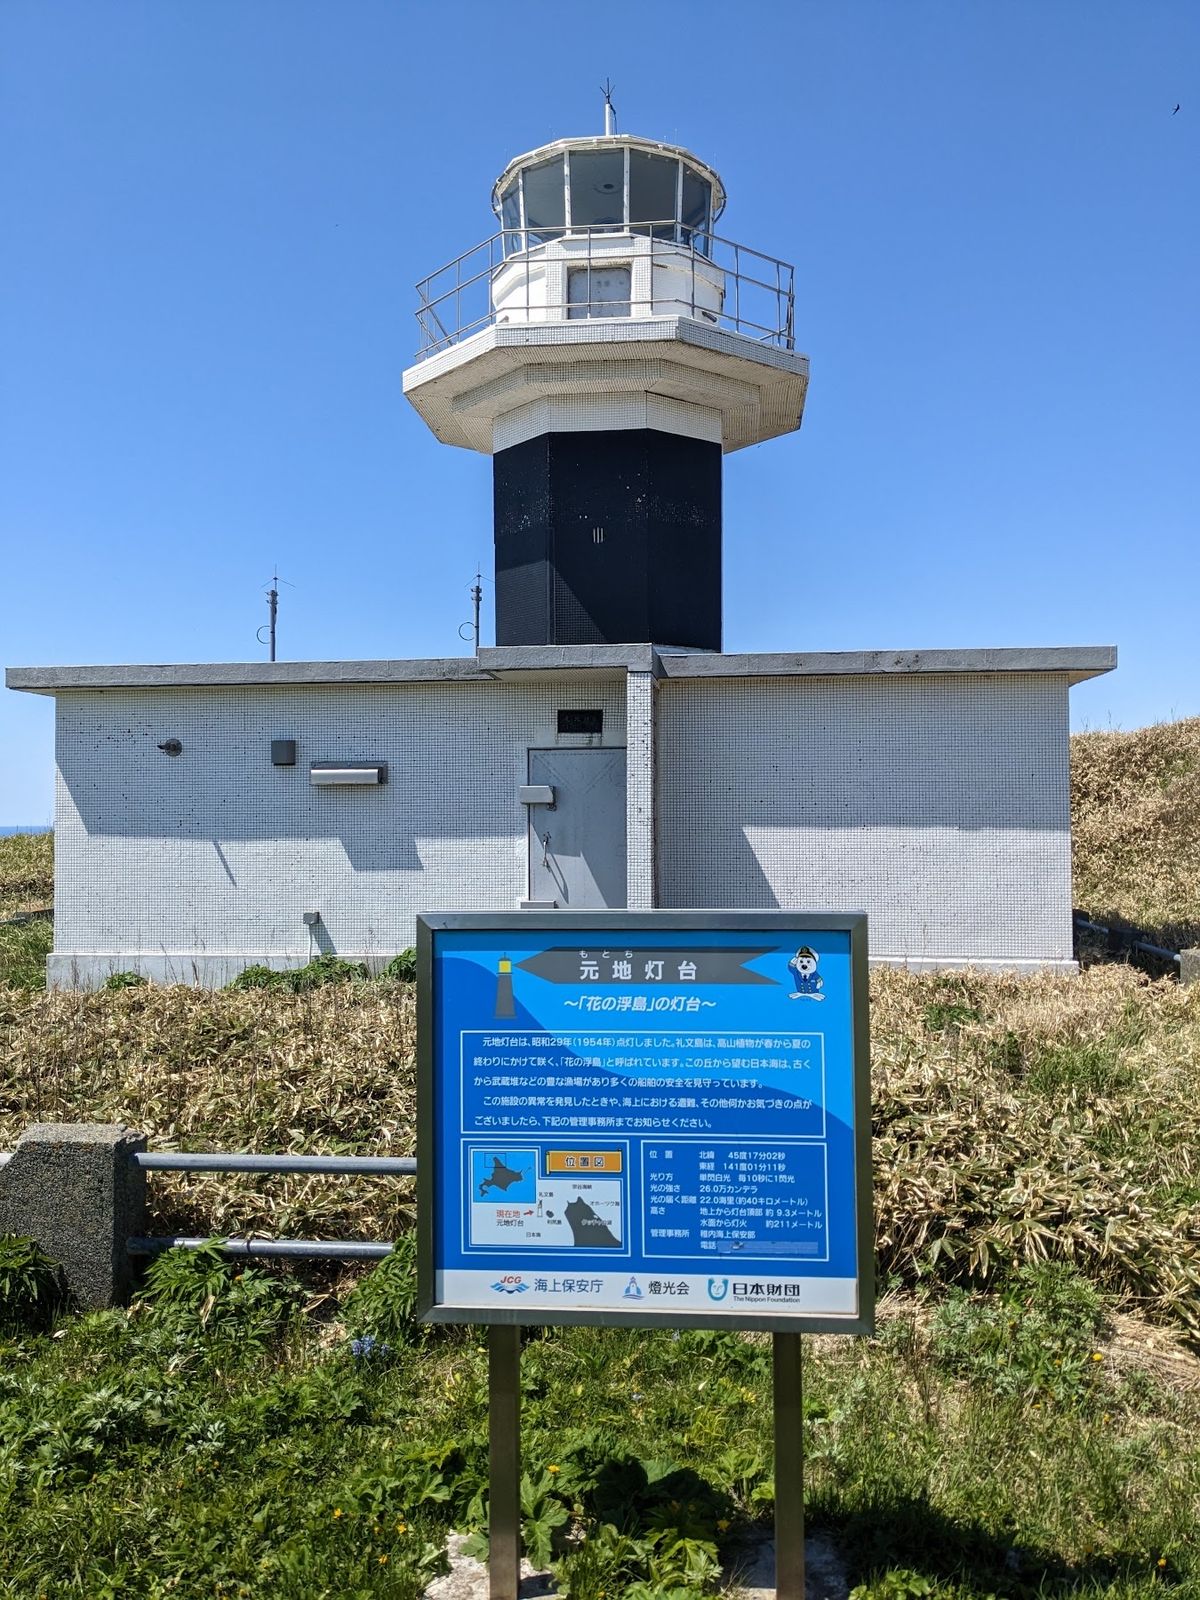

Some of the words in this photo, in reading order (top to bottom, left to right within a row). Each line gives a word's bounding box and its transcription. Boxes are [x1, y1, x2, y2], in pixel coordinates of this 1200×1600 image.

[579, 950, 634, 959] もとち
[579, 960, 697, 980] 元地灯台
[474, 1115, 712, 1128] ございましたら、下記の管理事務所までお知らせください。
[699, 1151, 715, 1160] 北緯
[728, 1151, 786, 1161] 45度17分02秒
[699, 1162, 715, 1171] 東経
[723, 1162, 786, 1172] 141度01分11秒
[650, 1172, 674, 1181] 光り方
[650, 1184, 681, 1193] 光の強さ
[700, 1184, 758, 1193] 26.0万カンデラ
[650, 1195, 697, 1204] 光の届く距離
[496, 1209, 521, 1219] 現在地
[650, 1206, 666, 1215] 高さ
[776, 1209, 822, 1218] 9.3メートル
[496, 1219, 524, 1227] 元地灯台
[700, 1218, 747, 1228] 水面から灯火
[765, 1219, 823, 1229] 約211メートル
[650, 1229, 690, 1238] 管理事務所
[700, 1230, 756, 1239] 稚内海上保安部
[701, 1241, 717, 1249] 電話
[500, 1275, 522, 1284] JCG
[534, 1278, 604, 1293] 海上保安庁
[648, 1280, 690, 1295] 燈光会
[732, 1283, 800, 1296] 日本財団
